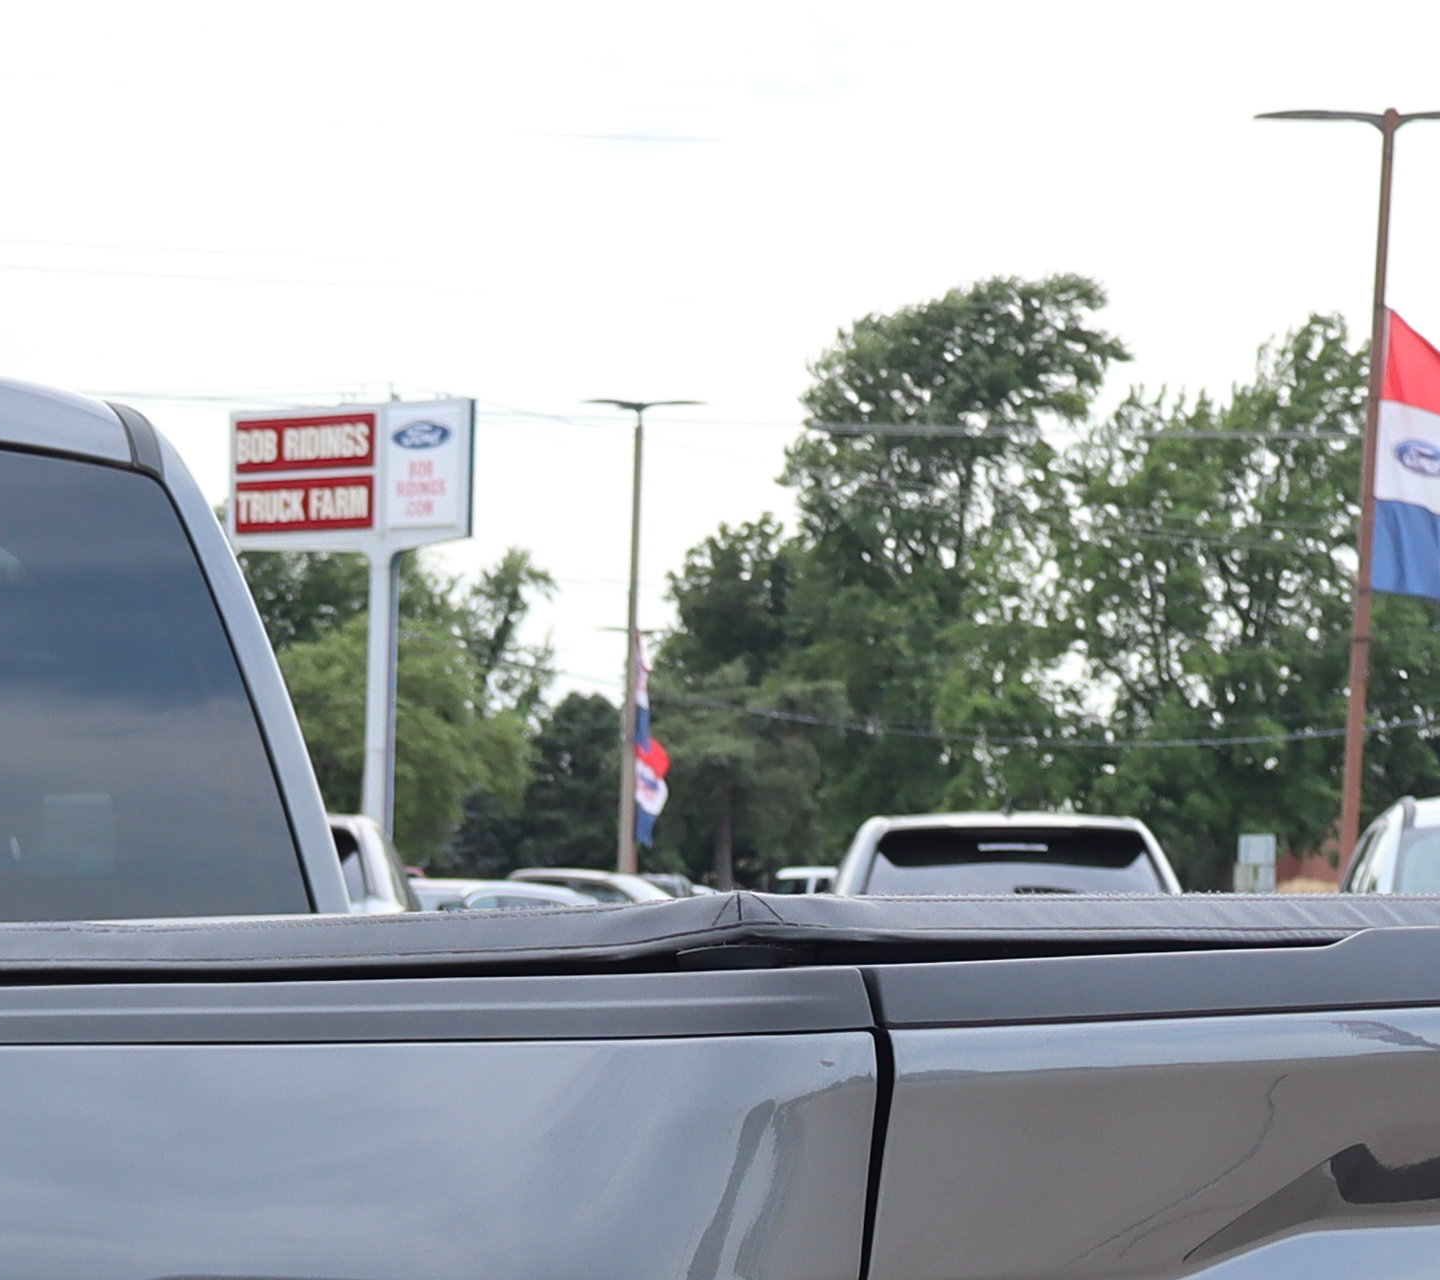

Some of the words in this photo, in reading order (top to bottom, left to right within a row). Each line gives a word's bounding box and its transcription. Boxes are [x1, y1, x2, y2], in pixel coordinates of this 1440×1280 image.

[236, 429, 278, 464] BOB
[283, 422, 370, 461] RIDINGS
[236, 487, 305, 524] TRUCK
[308, 485, 369, 520] FARM
